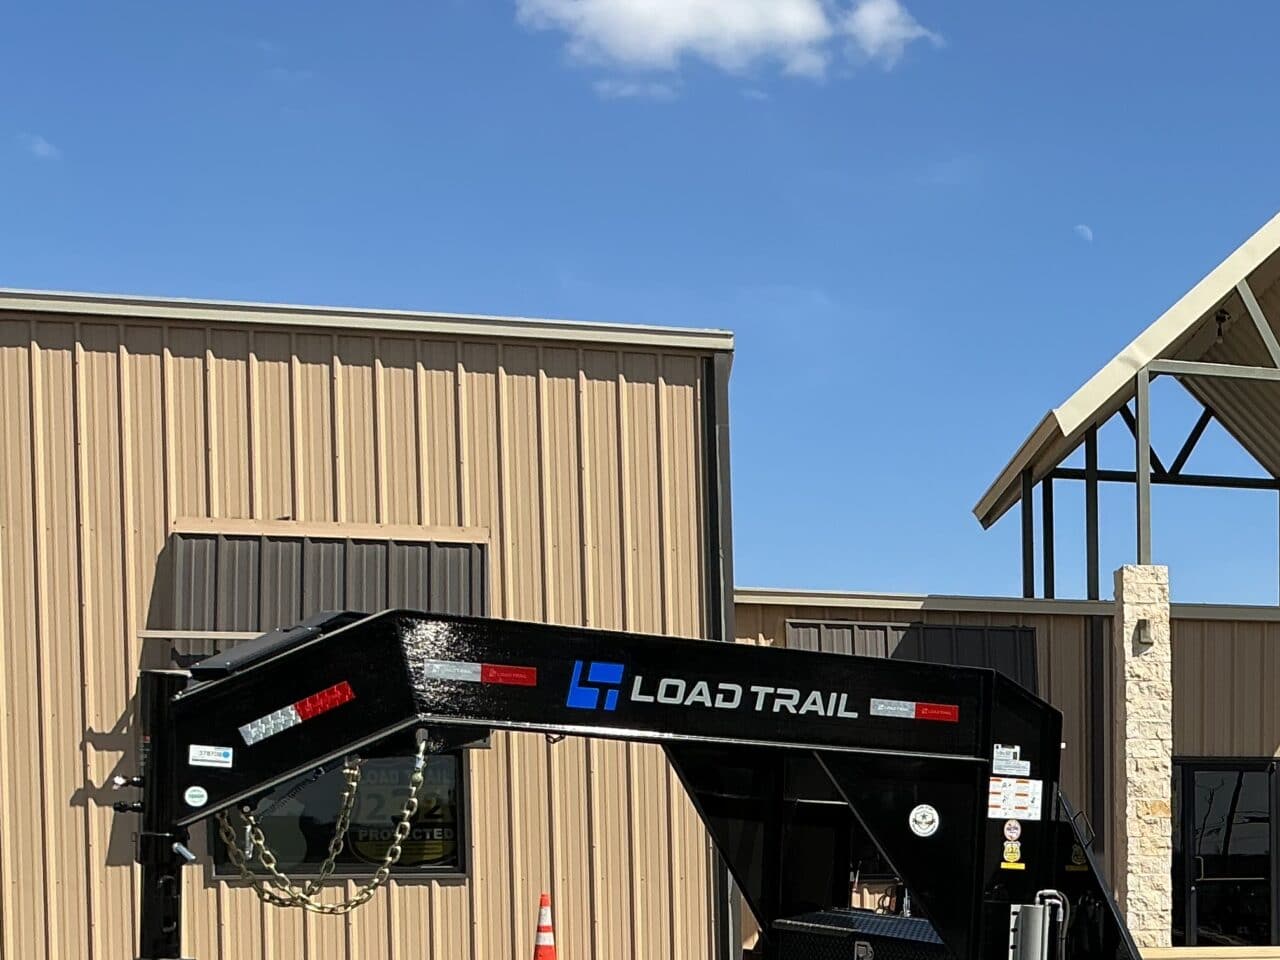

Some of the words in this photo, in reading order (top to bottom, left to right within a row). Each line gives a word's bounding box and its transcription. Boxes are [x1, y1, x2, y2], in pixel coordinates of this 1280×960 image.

[630, 675, 742, 709] LOAD
[750, 685, 859, 719] TRAIL
[401, 769, 451, 785] TAIL
[358, 827, 455, 841] PROCTED
